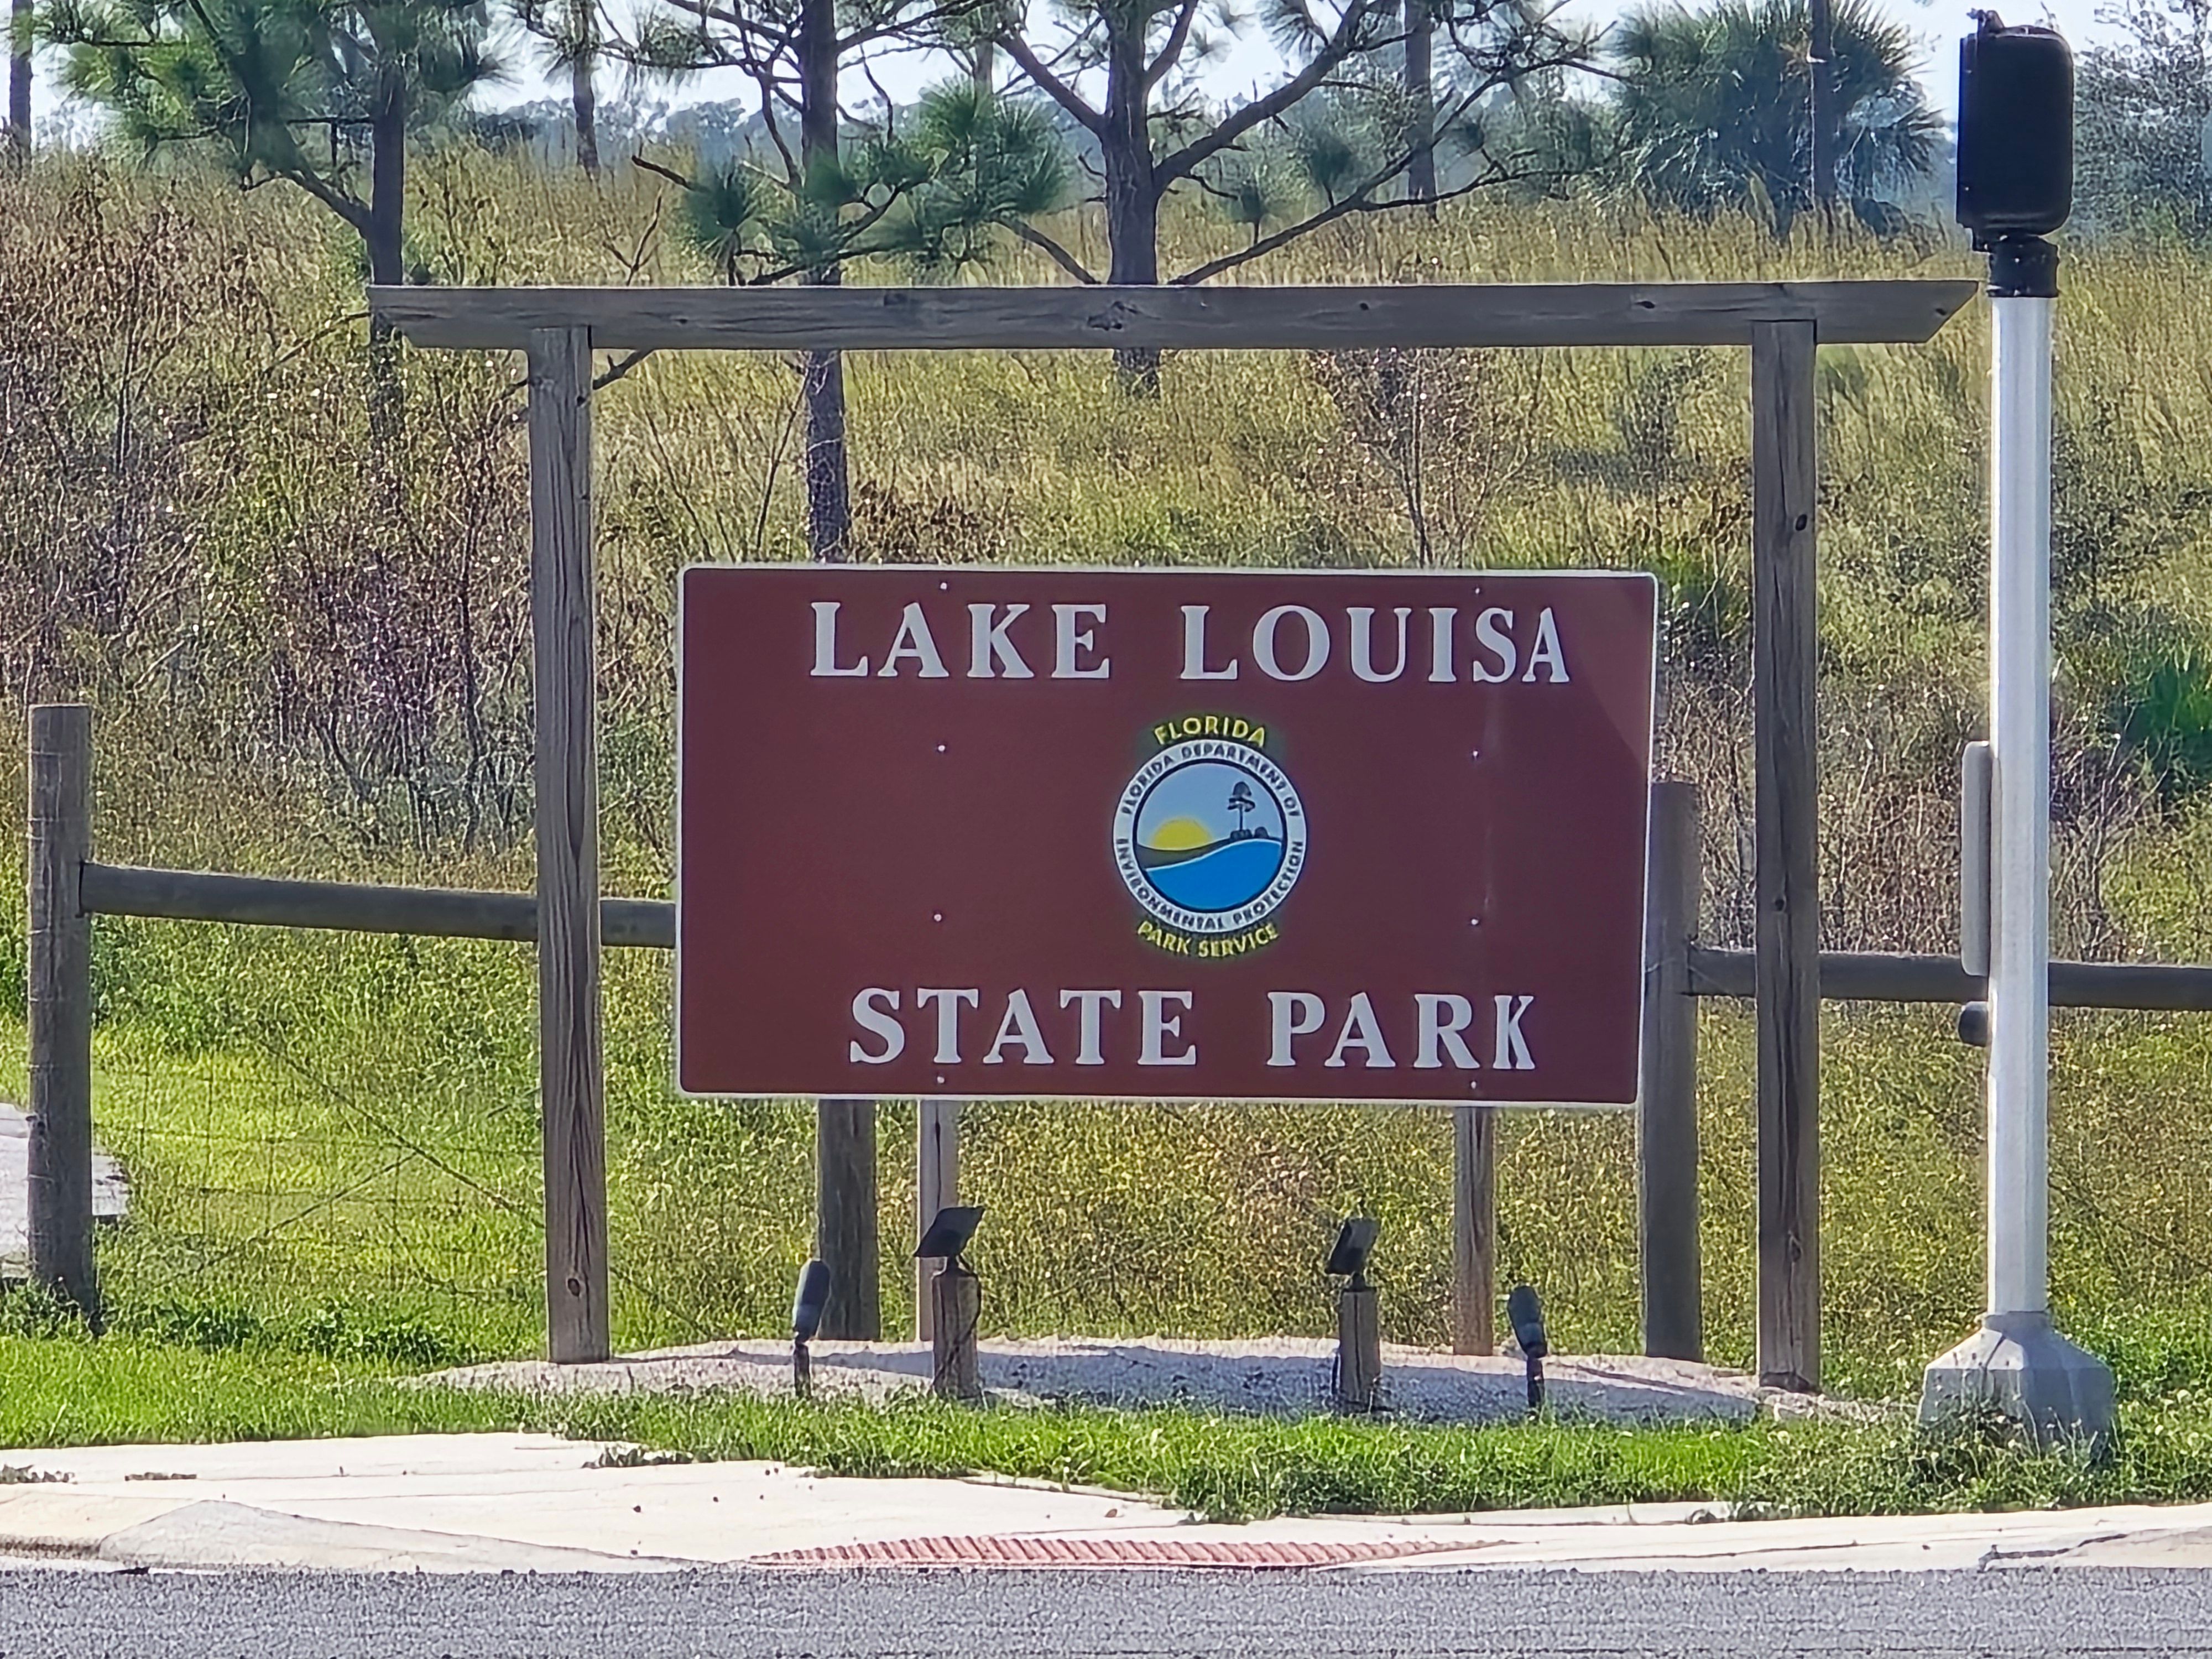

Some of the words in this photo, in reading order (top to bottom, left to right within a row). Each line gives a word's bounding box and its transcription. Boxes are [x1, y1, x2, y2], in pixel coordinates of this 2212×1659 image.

[810, 602, 1109, 679] LAKE
[1178, 605, 1569, 683] LOUISA
[1154, 716, 1265, 747] FLORIDA
[1138, 920, 1190, 955] PARK
[1198, 922, 1280, 957] SERVICE
[850, 988, 1196, 1065] STATE
[1267, 992, 1535, 1070] PARK
